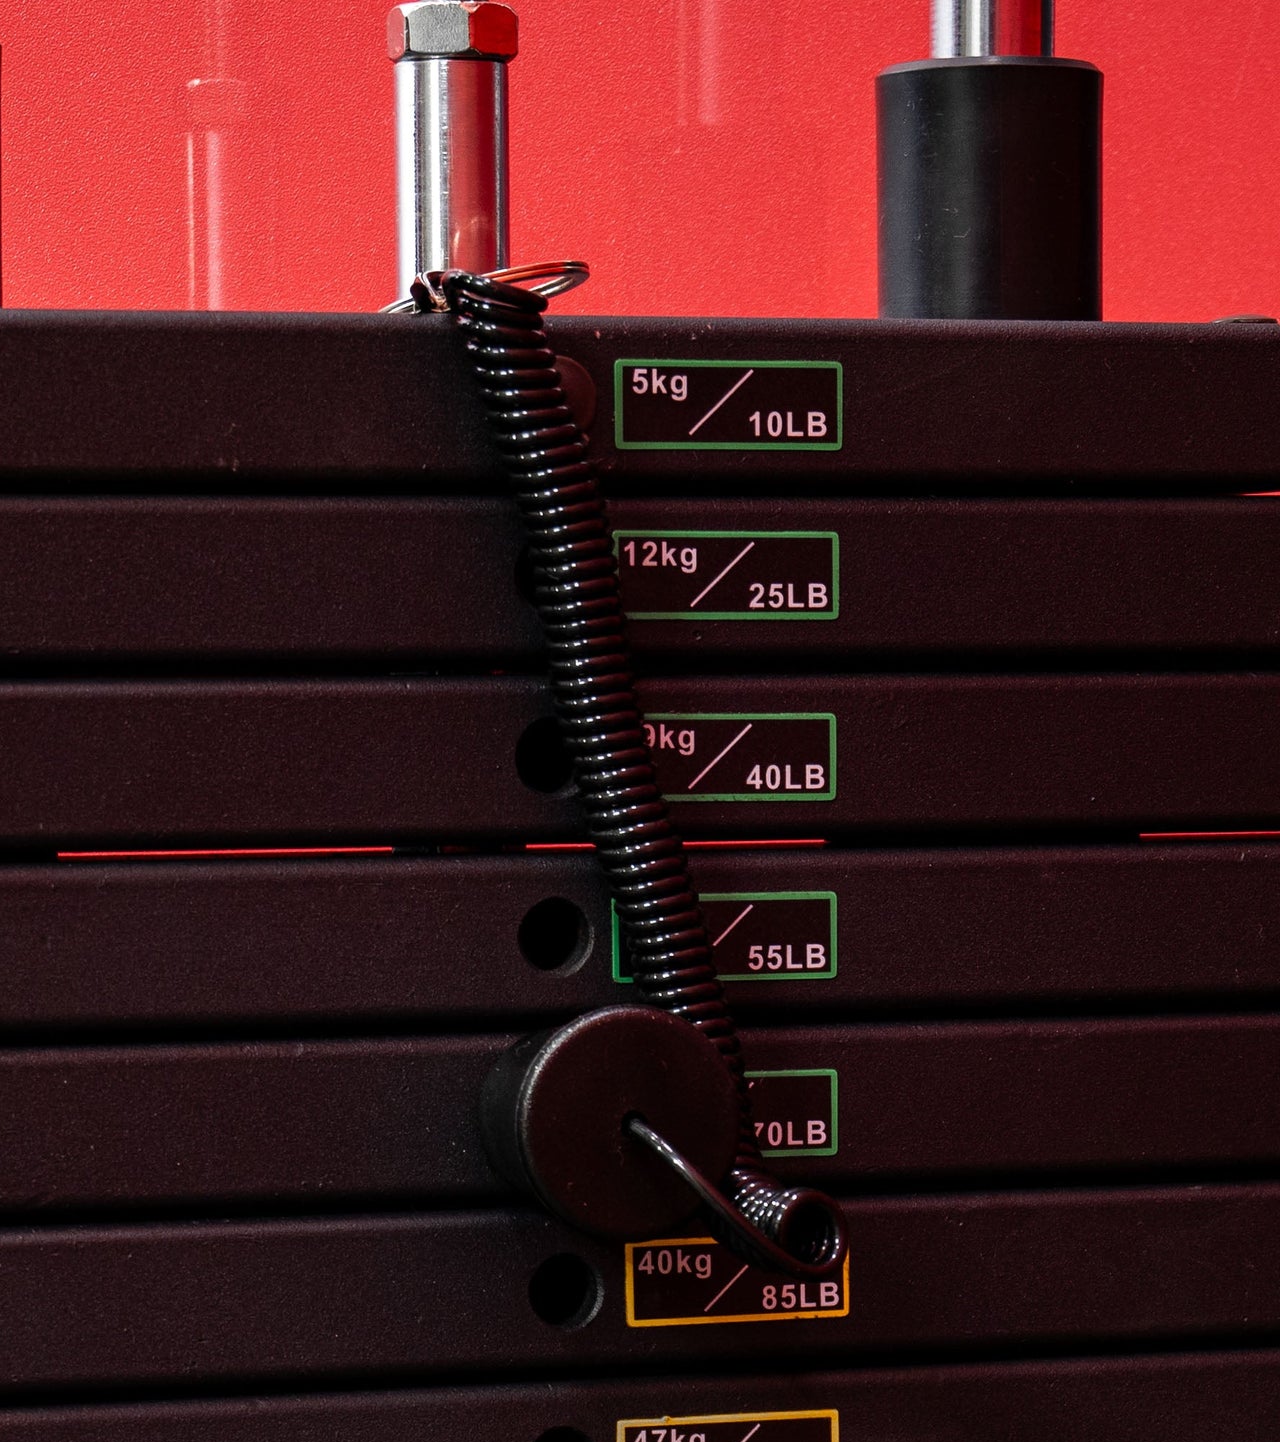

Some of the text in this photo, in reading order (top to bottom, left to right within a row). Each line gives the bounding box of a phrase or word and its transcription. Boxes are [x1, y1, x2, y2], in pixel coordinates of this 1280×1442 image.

[632, 368, 689, 401] 5kg
[749, 411, 828, 437] 10LB
[624, 541, 698, 574] 12kg
[749, 583, 828, 609] 25LB
[746, 764, 825, 790] 40LB
[748, 944, 826, 970] 55LB
[637, 1248, 712, 1279] 40kg
[762, 1281, 840, 1310] 85LB
